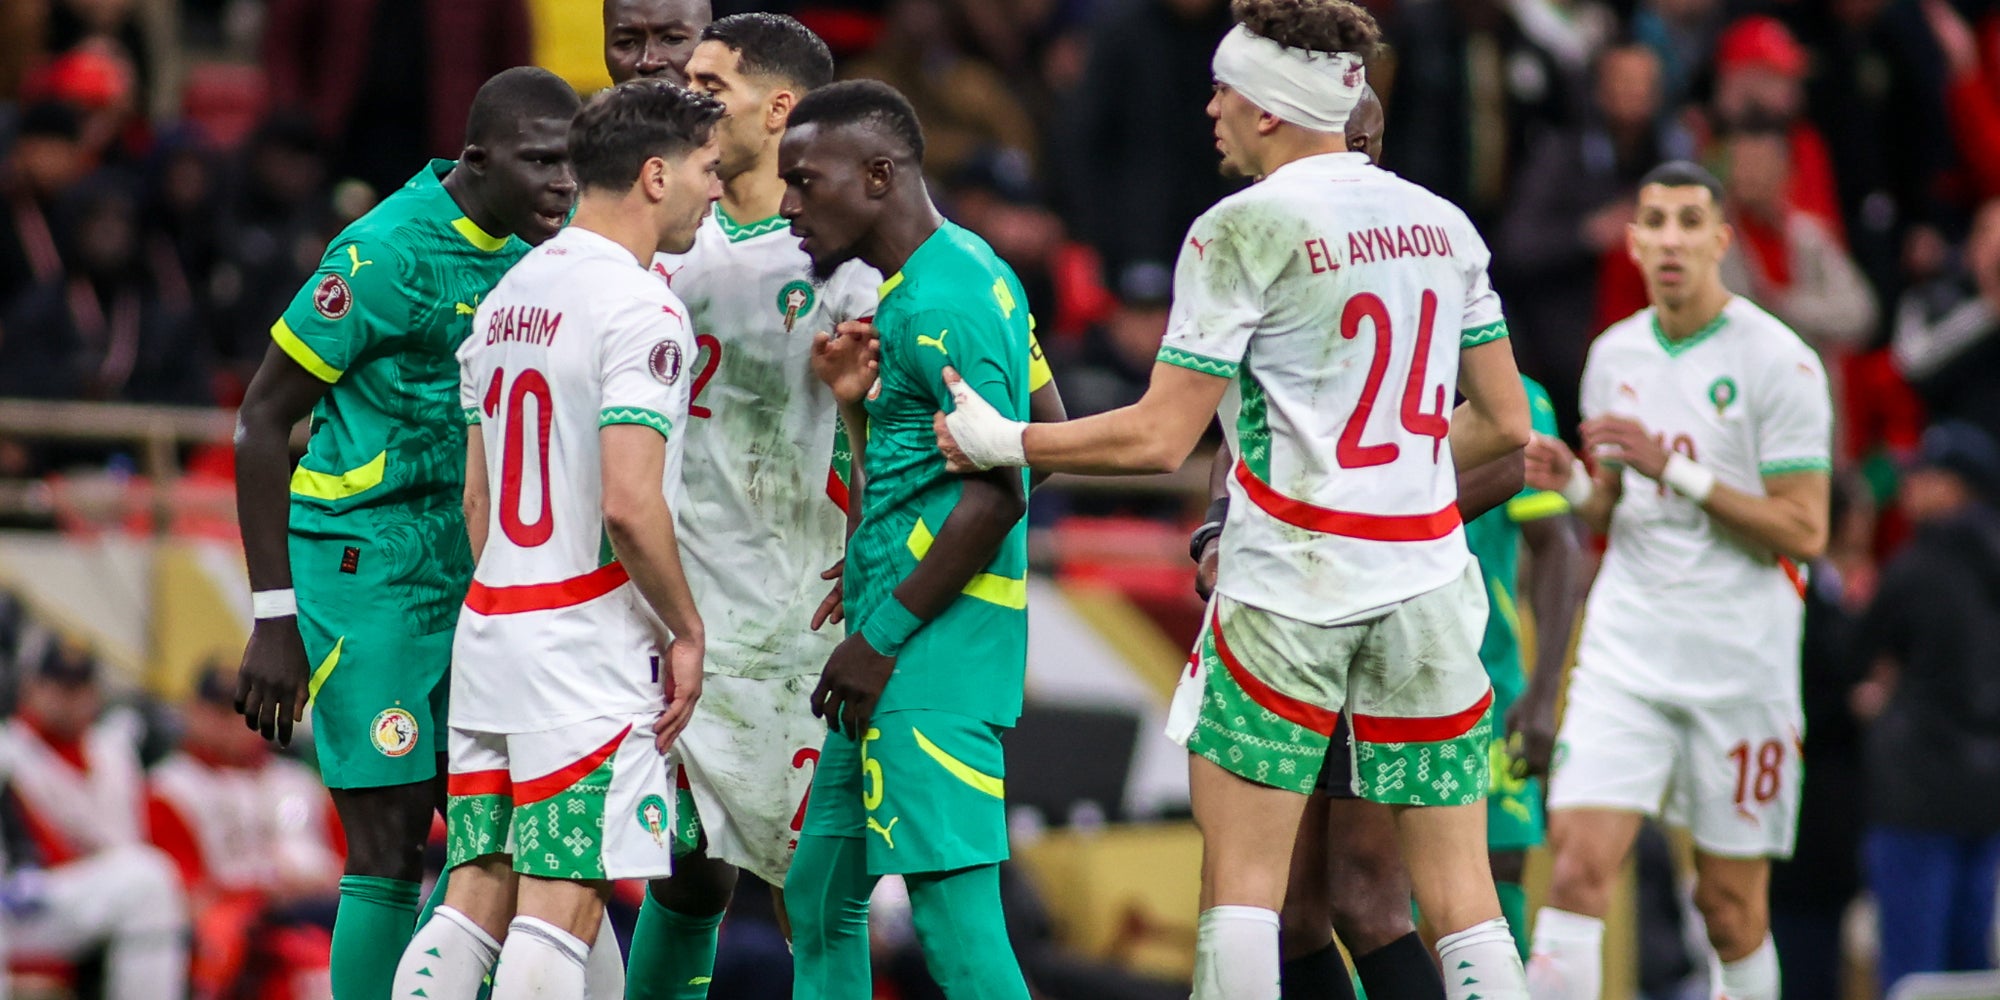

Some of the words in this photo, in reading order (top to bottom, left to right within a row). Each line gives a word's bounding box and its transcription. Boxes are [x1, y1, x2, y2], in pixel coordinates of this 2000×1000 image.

[1304, 237, 1341, 274] EL
[1348, 223, 1454, 266] AYNAOUI
[486, 305, 562, 347] BRAHIM
[688, 333, 722, 419] 2
[1335, 288, 1450, 470] 24
[861, 727, 884, 812] 5
[1727, 738, 1785, 804] 18
